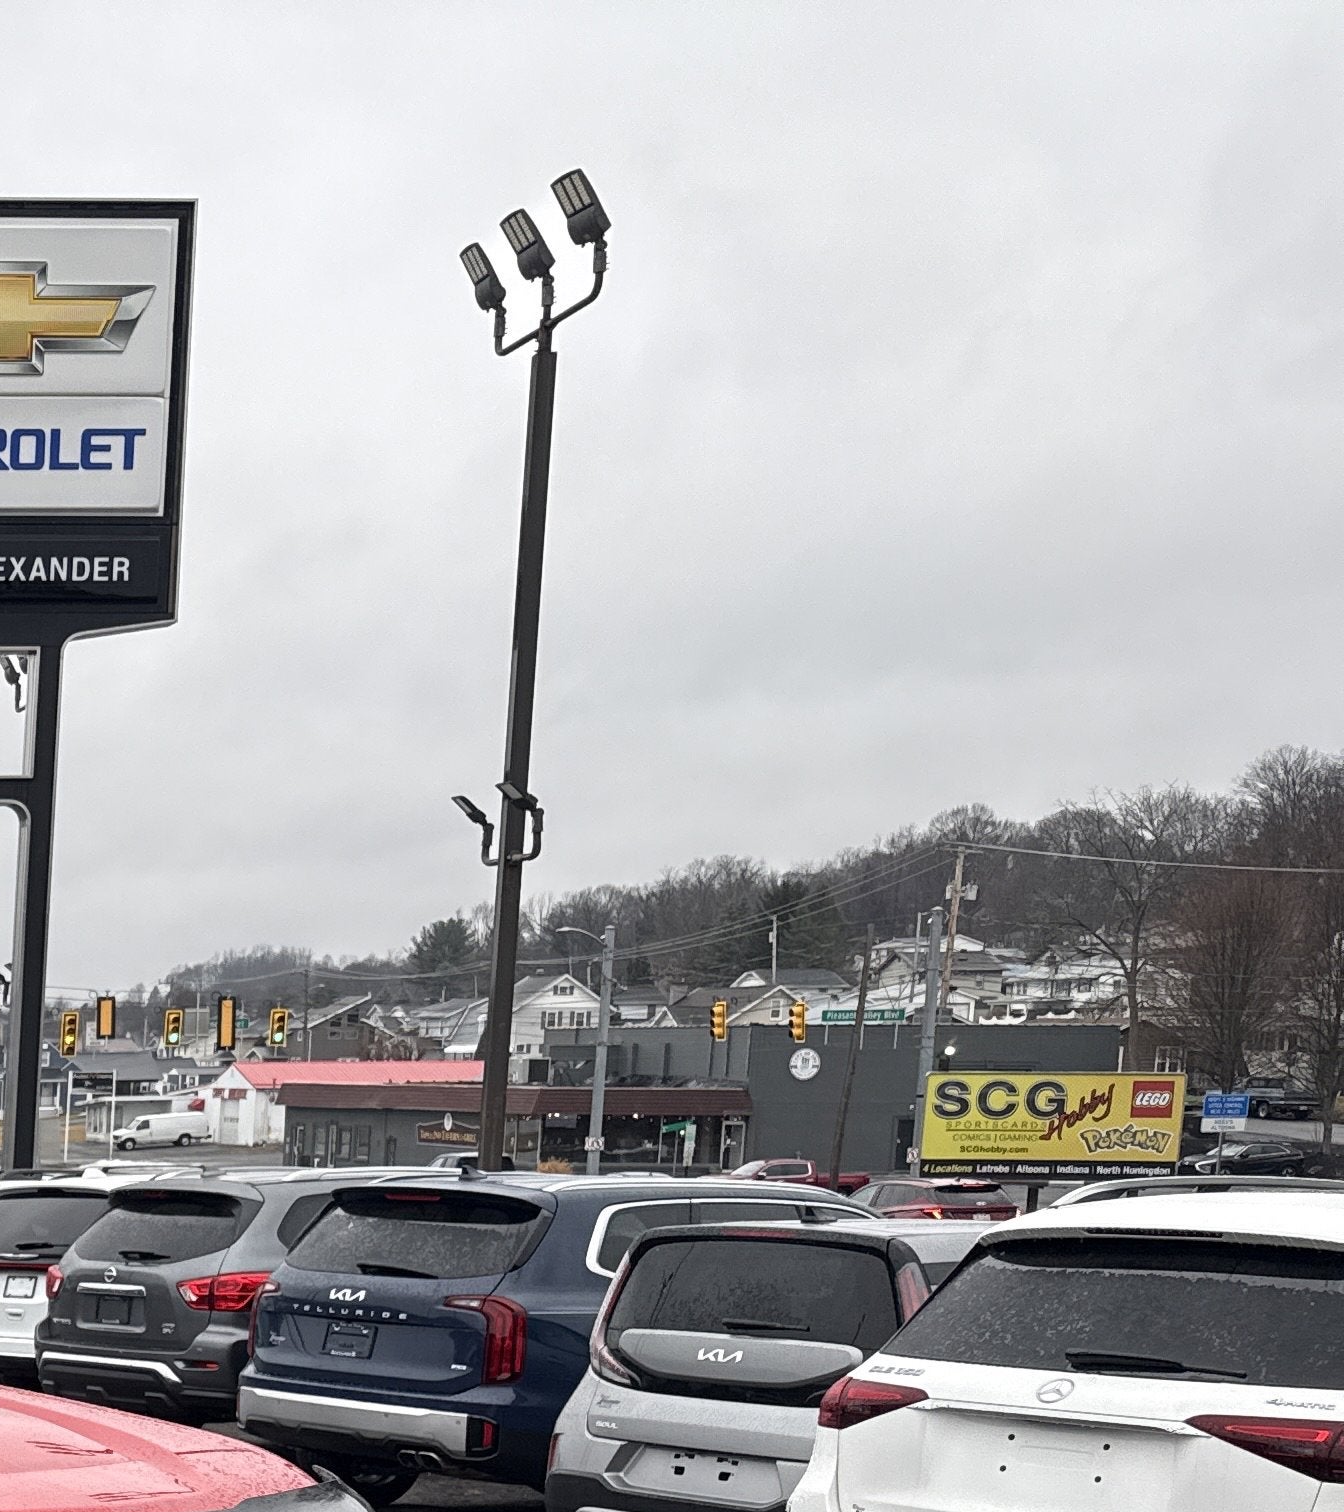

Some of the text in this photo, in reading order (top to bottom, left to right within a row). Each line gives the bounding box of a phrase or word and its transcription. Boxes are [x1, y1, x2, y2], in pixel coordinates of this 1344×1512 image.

[827, 1010, 856, 1020] Pleasan
[863, 1010, 882, 1021] alley
[1134, 1091, 1172, 1107] LEGO
[932, 1078, 1115, 1141] SCG Hobby
[945, 1120, 1047, 1130] SPORTSCARDS
[952, 1133, 1039, 1143] COMICS GAMING
[959, 1145, 1029, 1155] SCGhobby.com
[923, 1165, 930, 1173] 4
[930, 1165, 972, 1173] Locations
[976, 1165, 1009, 1174] Latrobe
[1016, 1165, 1049, 1174] Altoona
[1056, 1166, 1089, 1174] Indiana
[1097, 1166, 1121, 1175] North
[292, 1303, 408, 1320] TELLURIDE
[595, 1420, 619, 1429] SOUL
